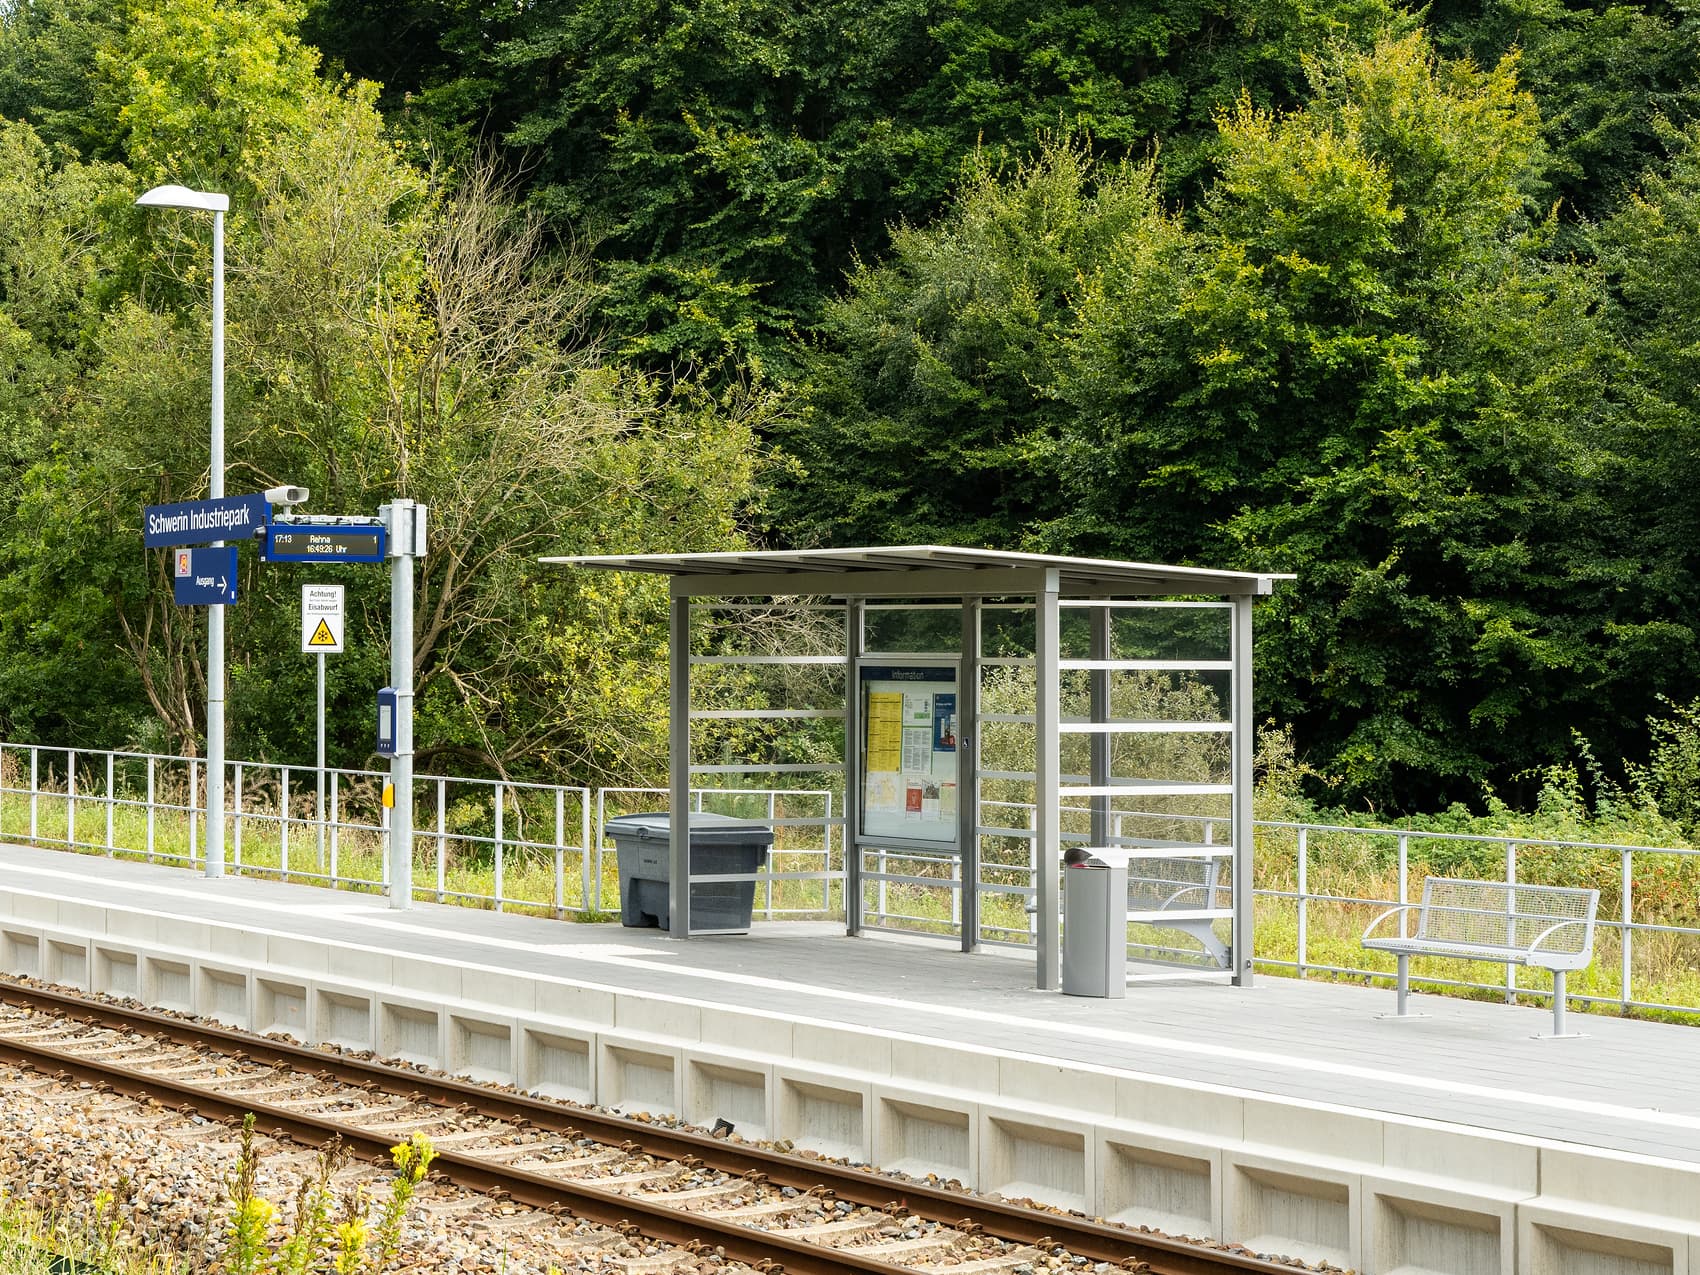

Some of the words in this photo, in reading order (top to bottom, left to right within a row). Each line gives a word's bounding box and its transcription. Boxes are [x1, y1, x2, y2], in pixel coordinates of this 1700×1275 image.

[149, 511, 188, 535] Schwerin
[190, 503, 250, 532] Industriepark
[274, 534, 293, 544] 17:13
[309, 534, 331, 544] Rehna
[372, 535, 377, 544] 1
[335, 544, 348, 553] Uhr
[195, 575, 214, 588] Ausgang
[309, 590, 337, 599] Achtung!
[308, 603, 338, 611] Eisabwurf
[891, 670, 924, 680] Information
